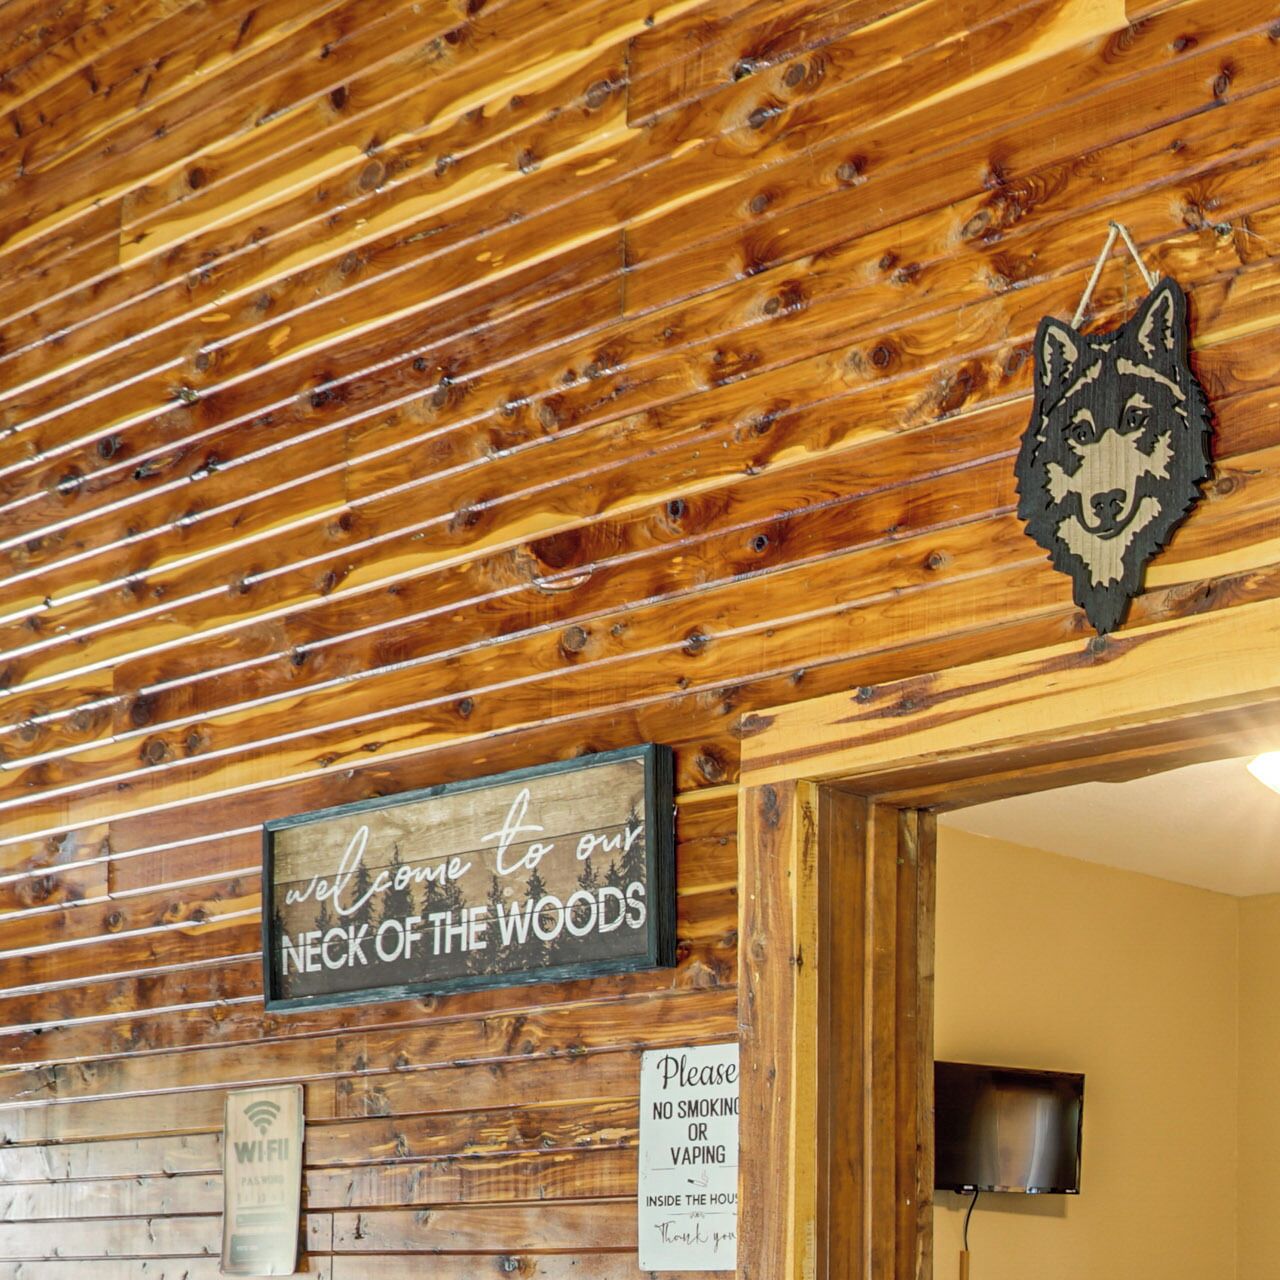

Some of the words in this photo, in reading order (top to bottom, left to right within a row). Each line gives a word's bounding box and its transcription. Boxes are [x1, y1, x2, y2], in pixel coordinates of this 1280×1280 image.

[285, 824, 472, 917] welcome
[481, 787, 555, 876] to
[575, 823, 643, 861] our
[281, 922, 369, 977] NECK
[375, 916, 422, 963] OF
[428, 905, 489, 956] THE
[496, 880, 647, 946] WOODS
[656, 1053, 739, 1090] Please
[652, 1101, 673, 1121] NO
[688, 1122, 708, 1142] OR
[670, 1144, 726, 1166] VAPING
[646, 1194, 681, 1207] INSIDE
[686, 1193, 707, 1206] THE
[654, 1220, 709, 1244] Thank
